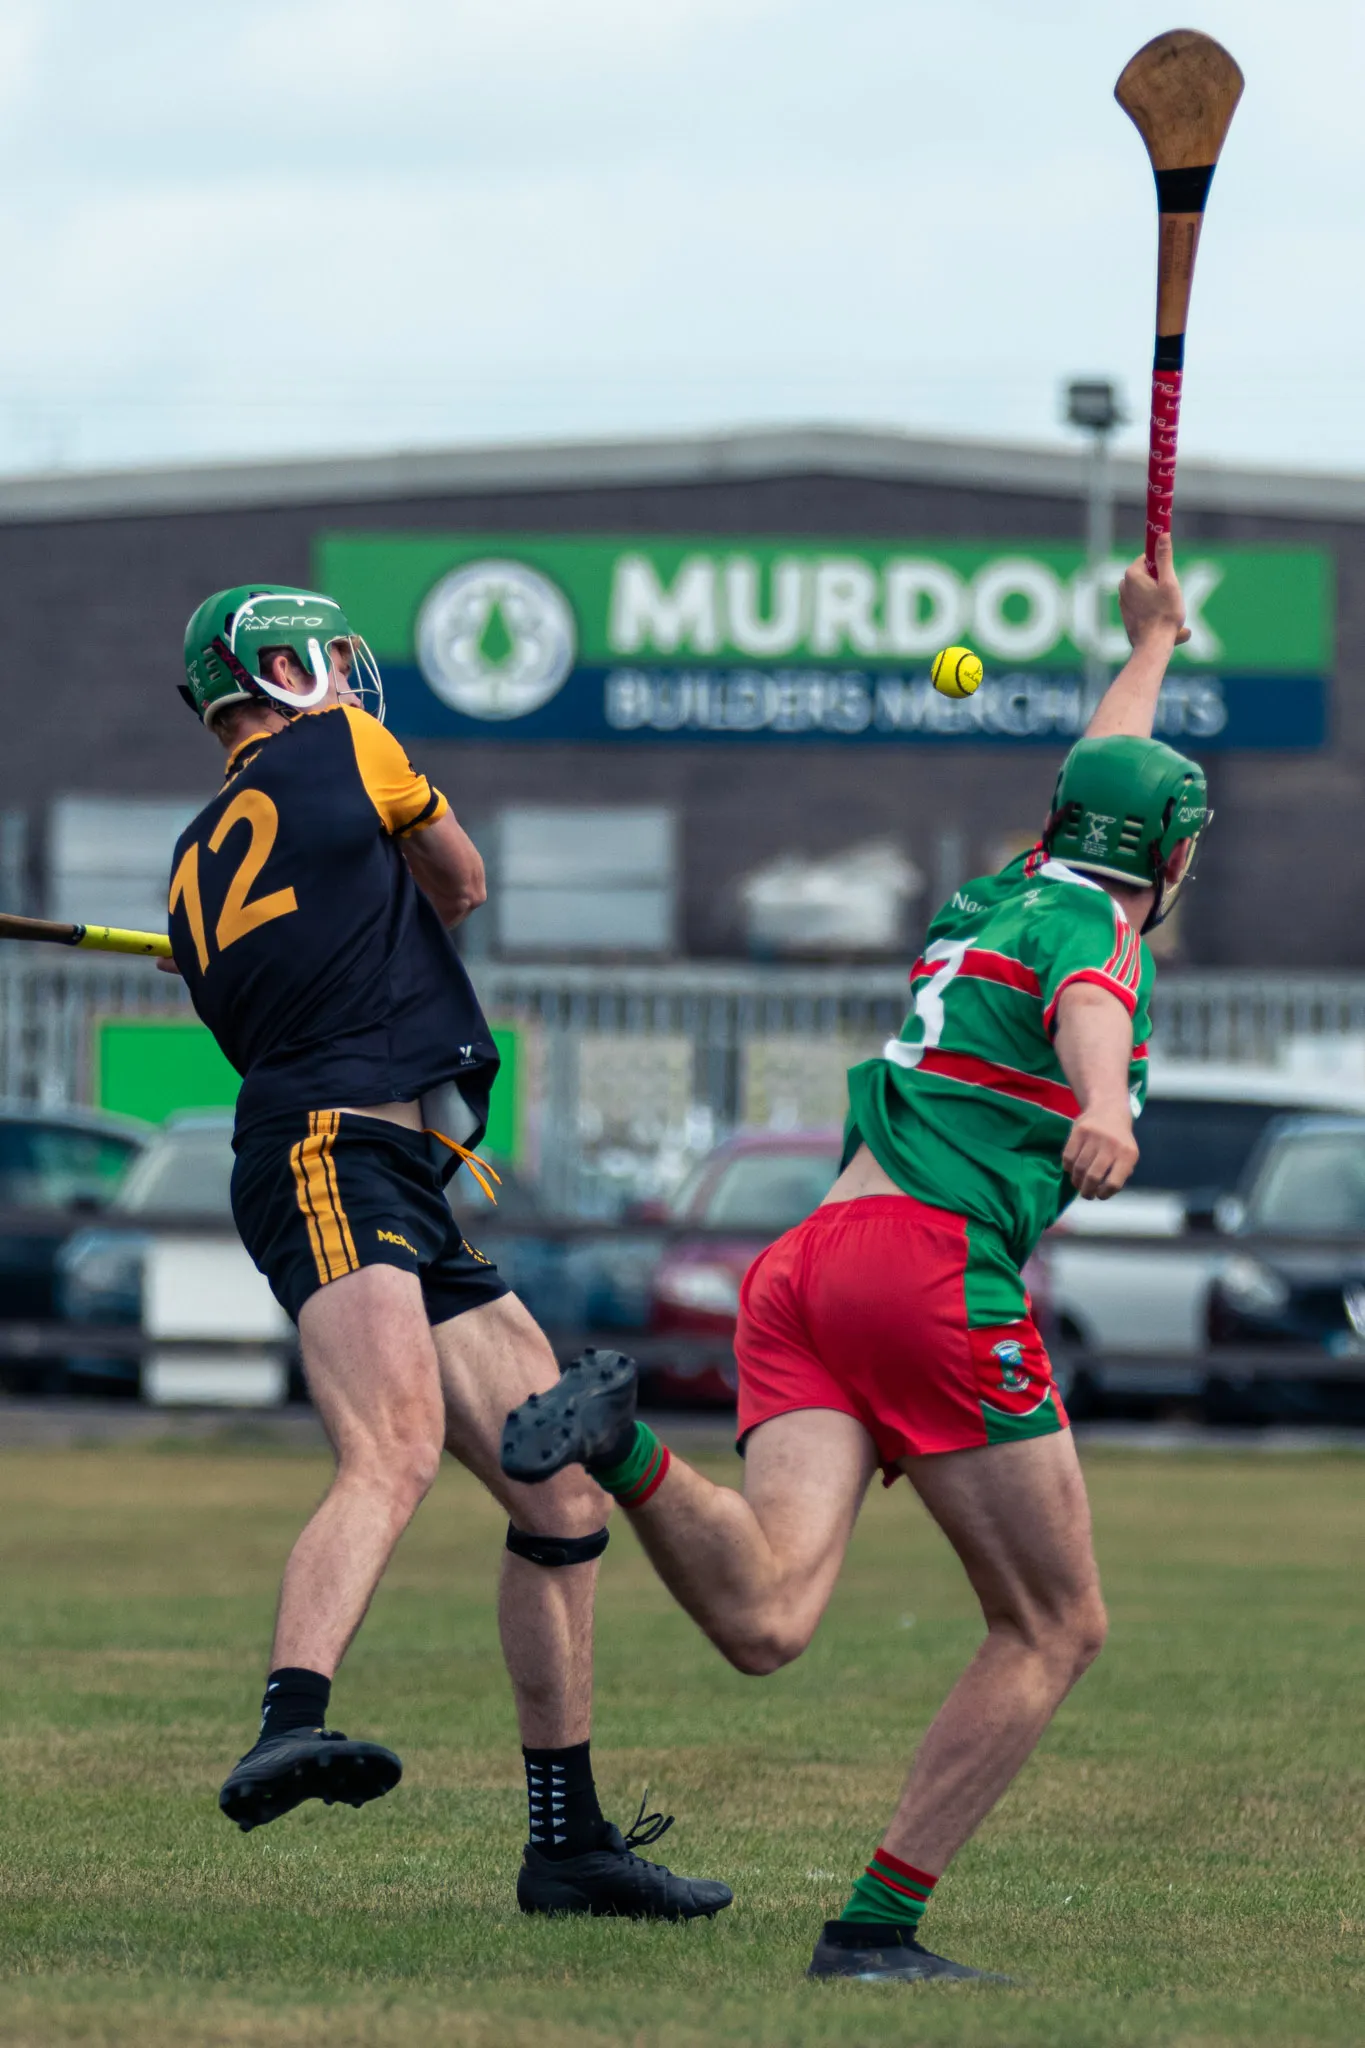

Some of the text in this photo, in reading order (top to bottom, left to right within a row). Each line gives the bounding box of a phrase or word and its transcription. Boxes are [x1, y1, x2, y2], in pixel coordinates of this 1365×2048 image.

[606, 554, 1226, 662] MURDOCK
[604, 667, 1228, 737] BUILDERS MERCHTS
[169, 788, 298, 976] 12
[884, 936, 978, 1068] 3
